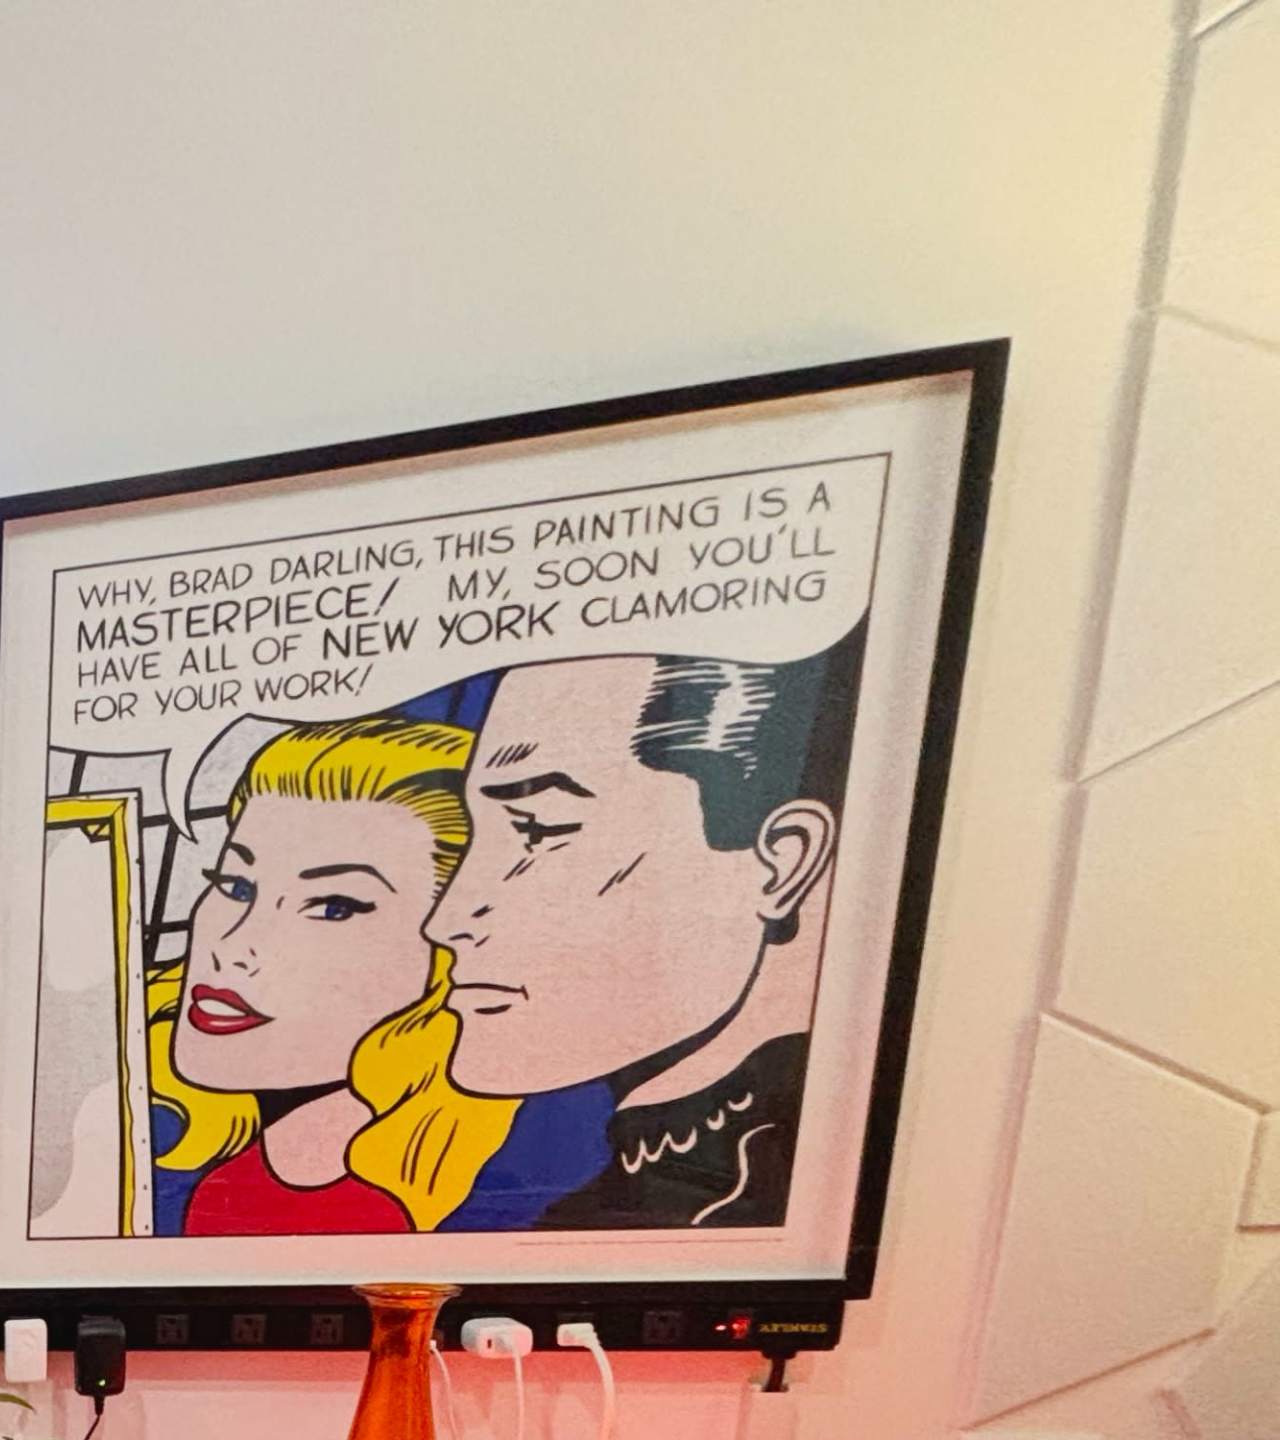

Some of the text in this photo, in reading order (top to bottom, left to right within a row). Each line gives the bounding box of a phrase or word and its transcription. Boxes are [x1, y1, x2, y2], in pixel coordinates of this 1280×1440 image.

[76, 523, 836, 654] MASTERPIECE! MY, SOON YOU'LL
[77, 480, 831, 609] WHY, BRAD DARLING, THIS PAINTING IS A
[77, 569, 827, 688] HAVE ALL OF NEW YORK CLAMORING
[73, 663, 375, 726] FOR YOUR WORK!
